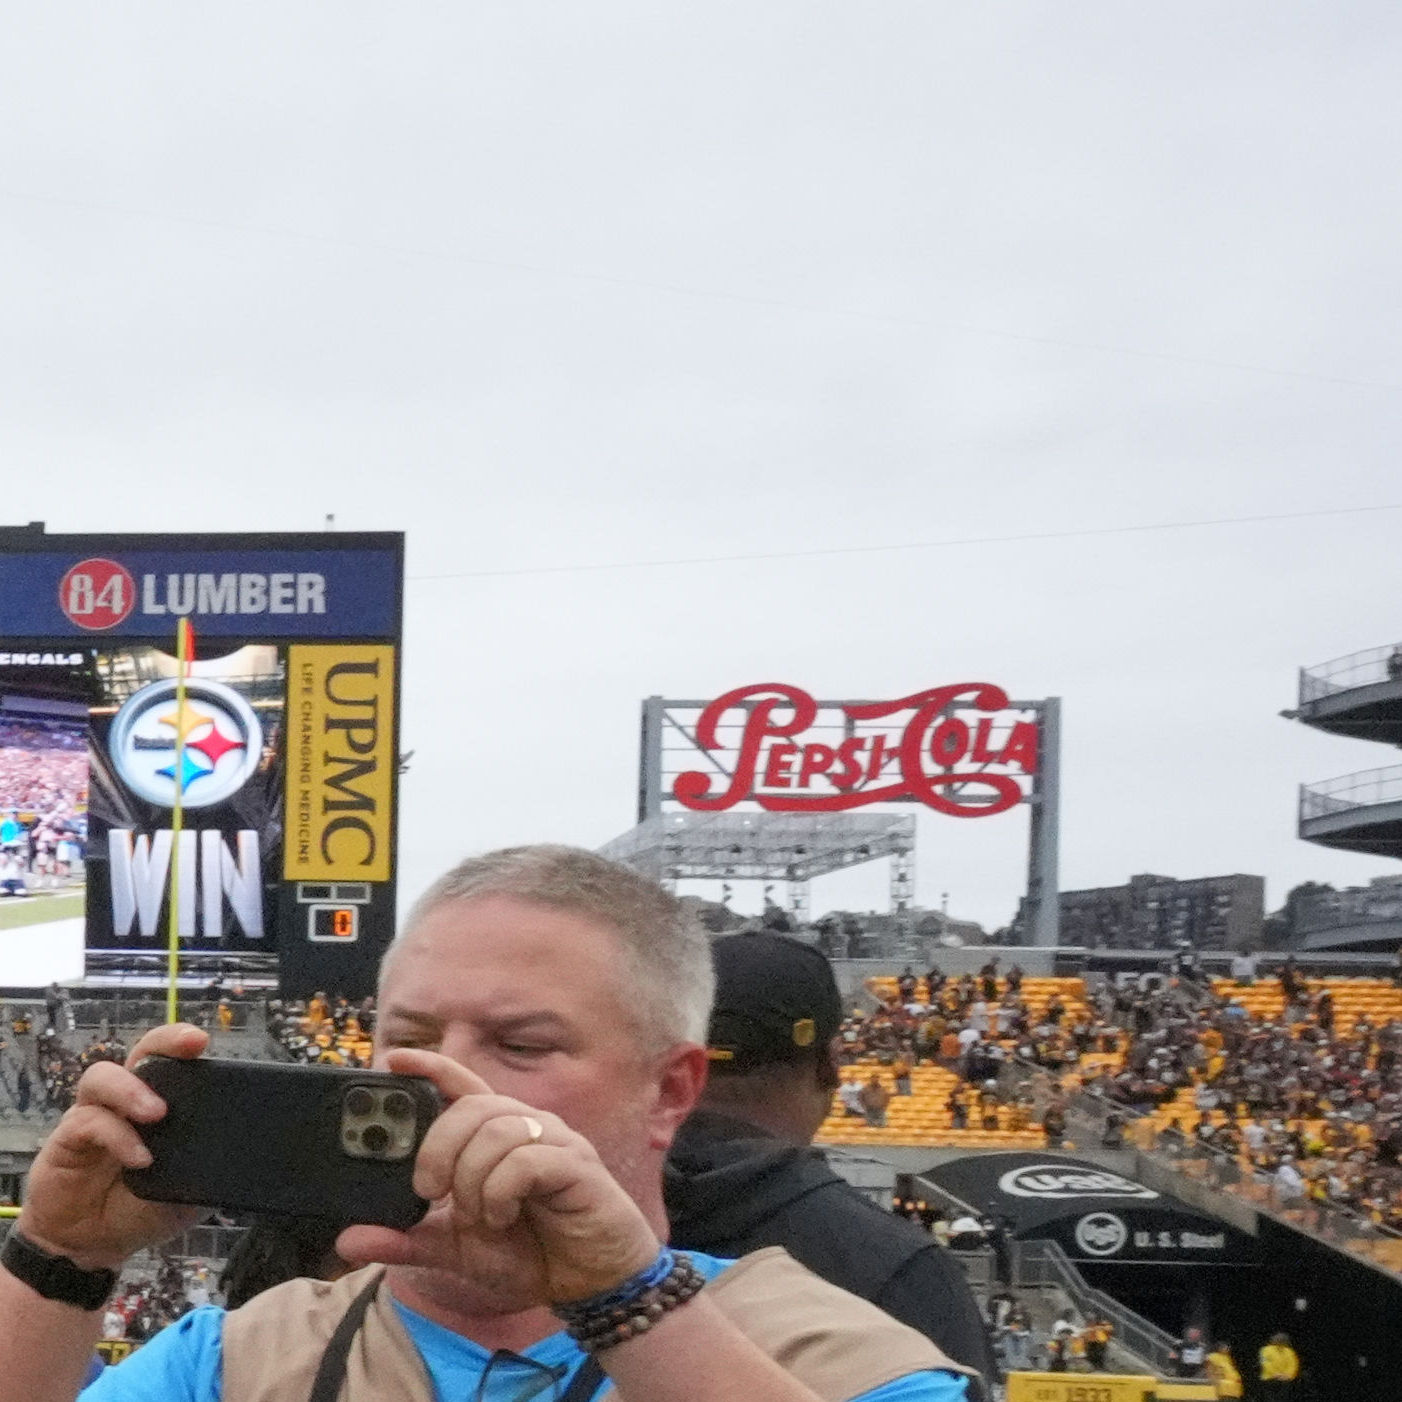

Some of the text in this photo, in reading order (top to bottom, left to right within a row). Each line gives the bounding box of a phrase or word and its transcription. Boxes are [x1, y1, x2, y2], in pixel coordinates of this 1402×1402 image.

[67, 573, 327, 615] 84 LUMBER
[299, 700, 314, 785] CHANGING
[320, 658, 380, 867] UPMC
[296, 789, 311, 865] MEDICINE
[107, 828, 264, 939] WIN
